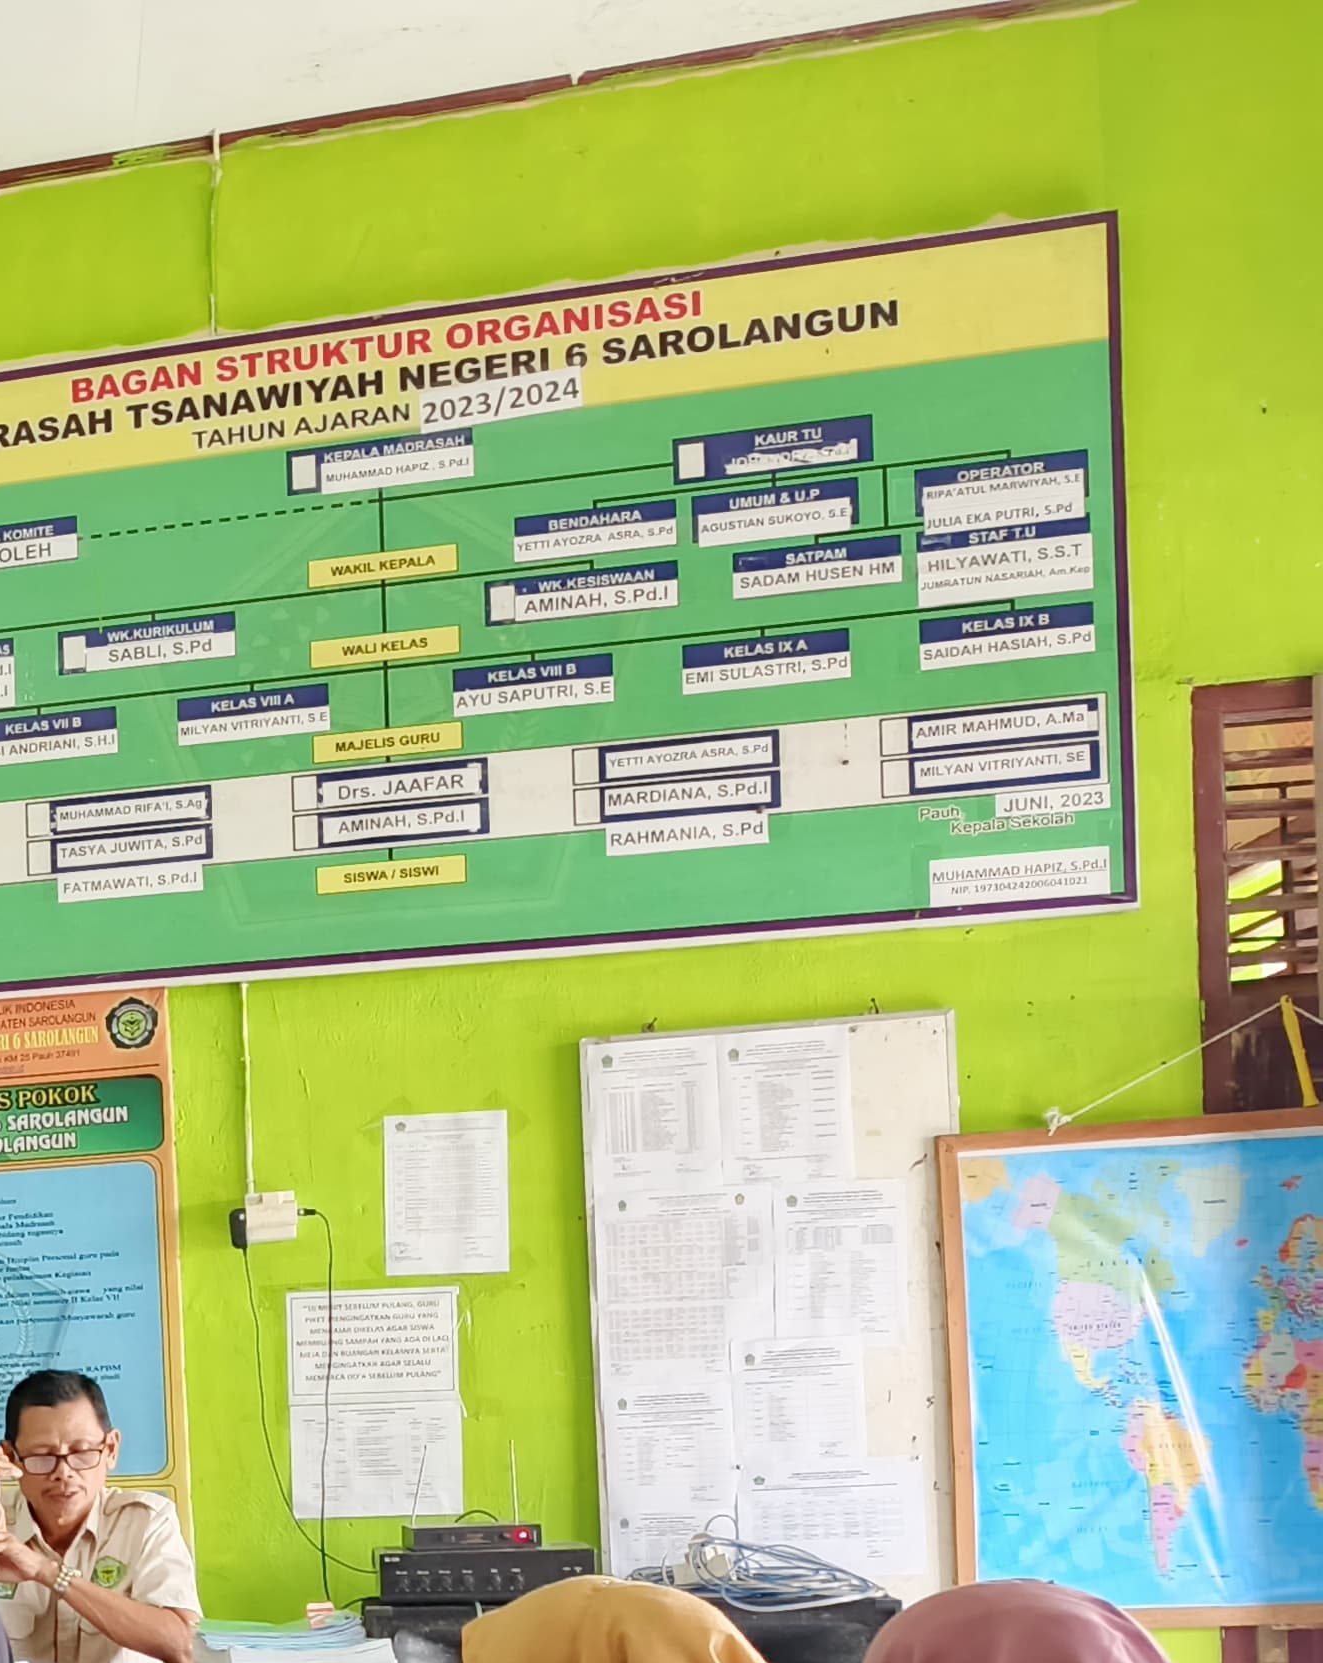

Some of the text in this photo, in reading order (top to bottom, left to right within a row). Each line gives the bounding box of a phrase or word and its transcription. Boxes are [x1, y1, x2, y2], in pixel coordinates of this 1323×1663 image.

[71, 291, 700, 402] BAGAN STRUKTUR ORGANISASI
[126, 371, 383, 427] TSANAWIYAH
[399, 348, 549, 390] NEGERI
[565, 342, 587, 366] 6
[602, 301, 897, 363] SAROLANGUN
[191, 378, 579, 448] TAHUN AJARAN 2023/2024
[754, 427, 822, 445] KAUR TU
[957, 461, 1046, 482] OPERATOR
[729, 488, 819, 509] UMUM & U.P
[3, 525, 53, 540] KOMITE
[548, 510, 641, 532] BENDAHARA
[330, 555, 435, 576] WAKIL KEPALA
[785, 547, 846, 566] SATPAM
[928, 543, 1078, 571] HILYAWATI, S.S.T
[538, 570, 654, 592] WK.KESISWAAN
[740, 561, 894, 588] SADAM HUSEN HM
[524, 586, 667, 613] AMINAH, S.Pd.I
[107, 621, 213, 643] WK.KURIKULUM
[108, 638, 211, 662] SABLI, S.Pd
[341, 637, 427, 656] WALI KELAS
[923, 631, 1091, 660] SAIDAH HASIAH, S.Pd
[916, 711, 1084, 738] AMIR MAHMUD, A.Ma
[335, 732, 439, 751] MAJELIS GURU
[338, 774, 463, 800] Drs. JAAFAR
[1003, 791, 1103, 812] JUNI, 2023
[338, 809, 464, 832] AMINAH, S.Pd.I
[17, 1085, 97, 1109] POKOK
[7, 1106, 127, 1129] SAROLANGUN
